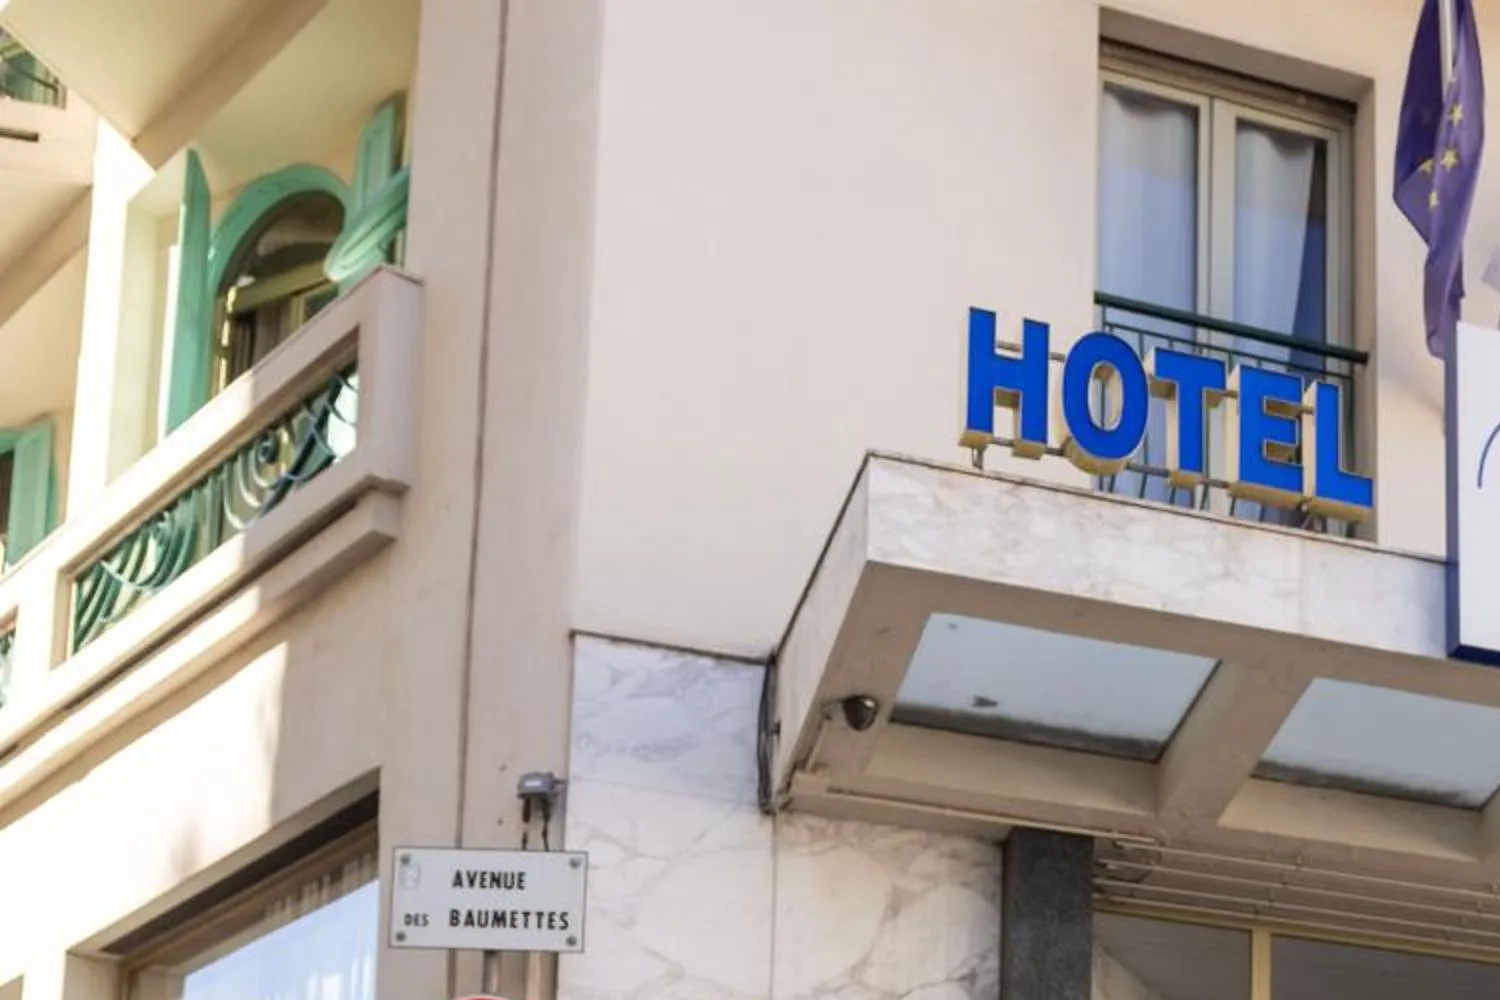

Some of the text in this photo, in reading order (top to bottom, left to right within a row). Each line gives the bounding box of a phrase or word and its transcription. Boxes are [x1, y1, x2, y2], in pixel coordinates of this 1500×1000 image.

[963, 306, 1374, 511] HOTEL
[452, 869, 527, 891] AVENUE
[404, 909, 570, 931] DES BAUMETTES
